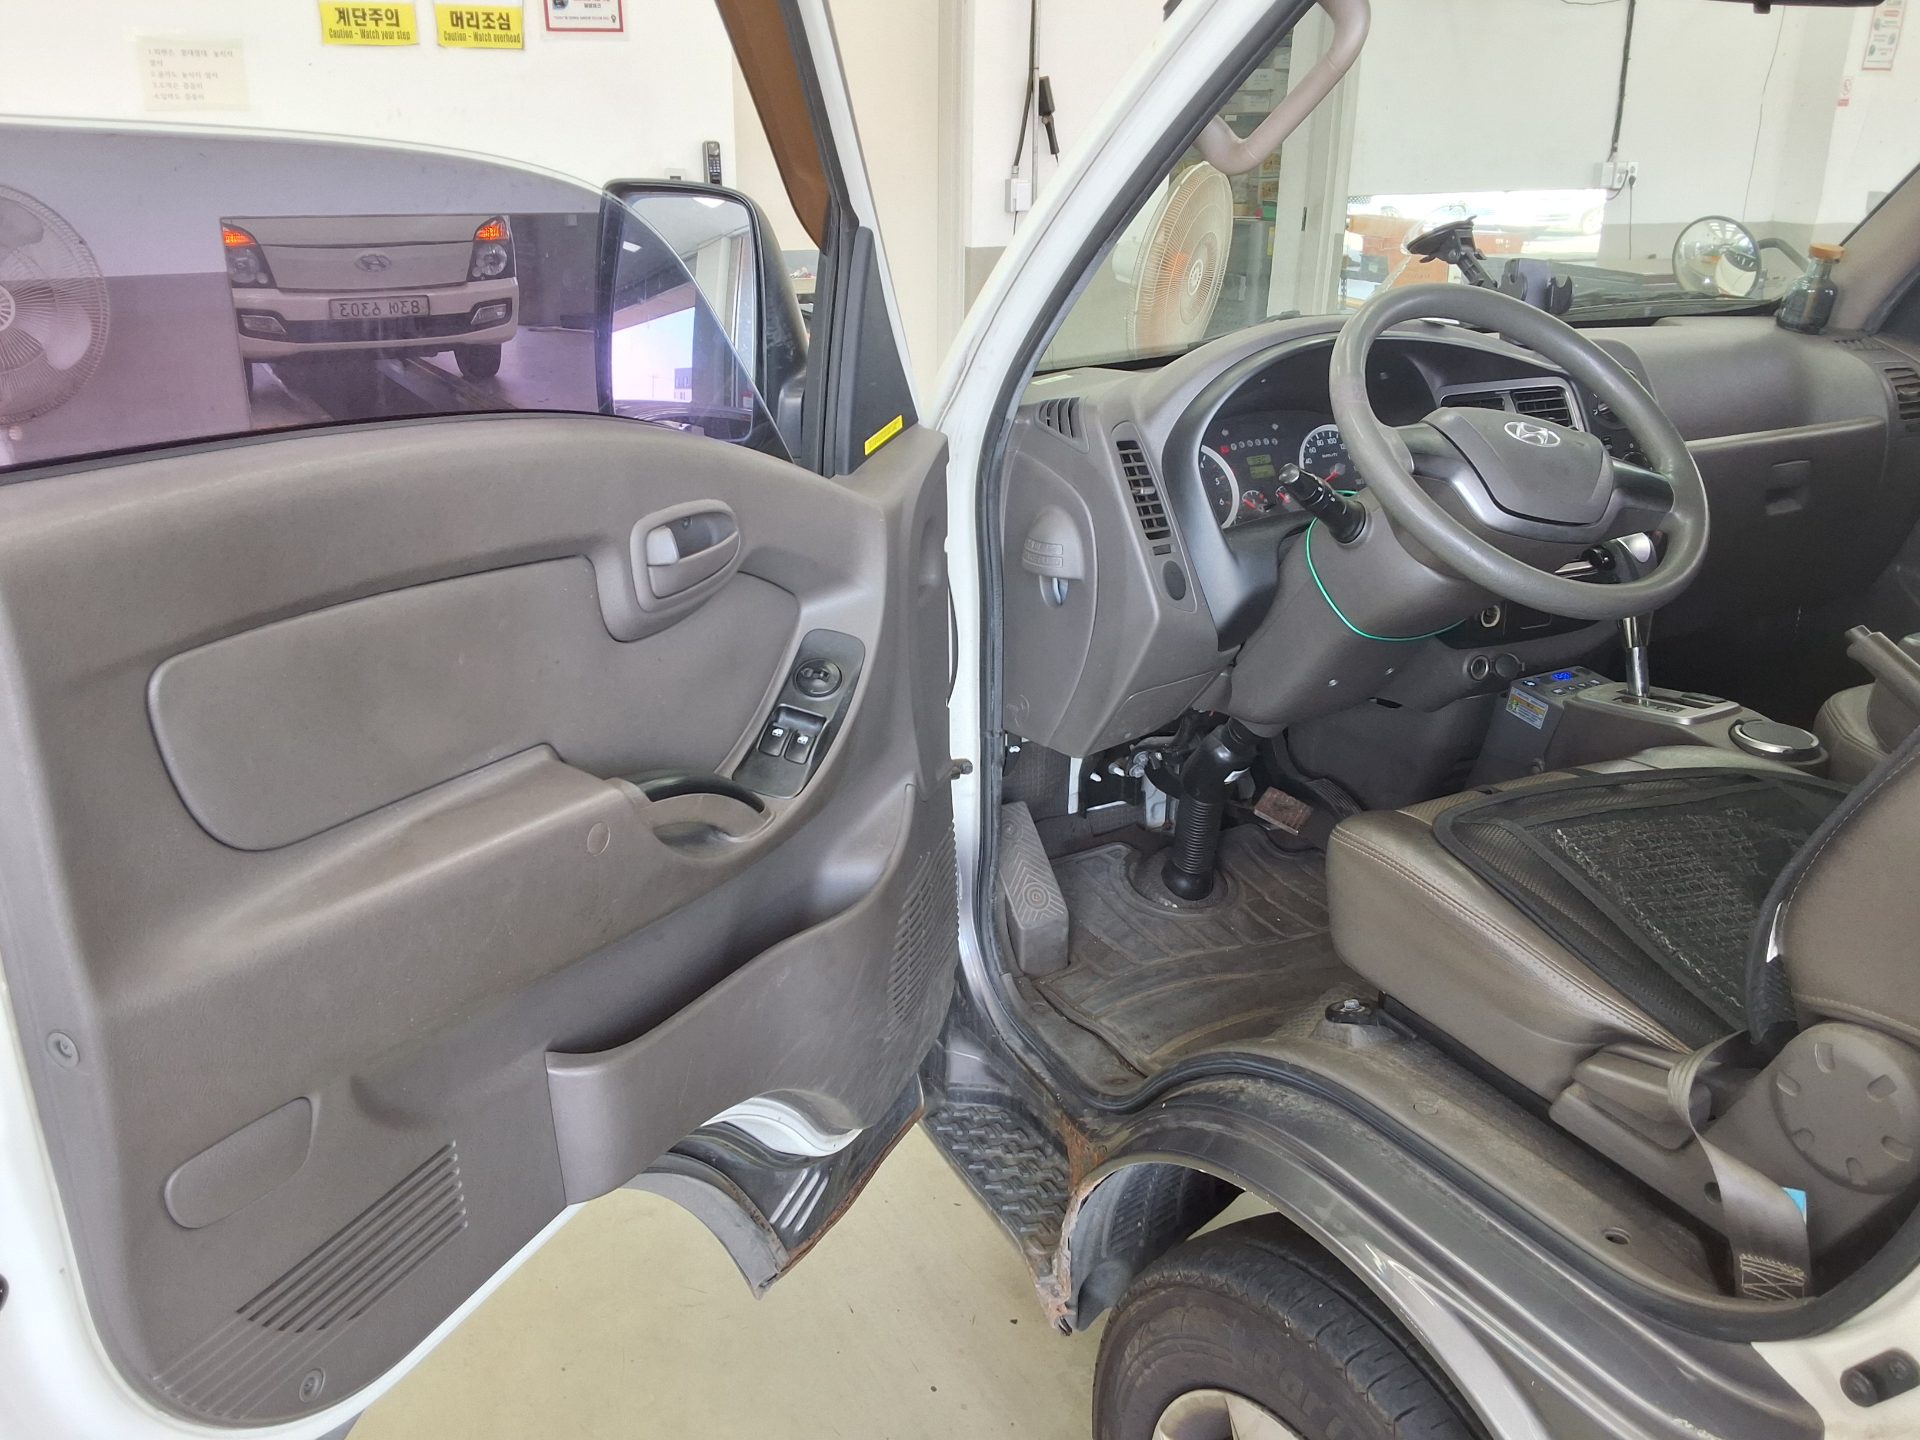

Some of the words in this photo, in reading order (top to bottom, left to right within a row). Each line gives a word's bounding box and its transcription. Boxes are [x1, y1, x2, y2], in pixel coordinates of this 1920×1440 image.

[334, 7, 401, 28] 계단주의
[449, 10, 512, 31] 머리조심
[328, 28, 354, 39] Caution
[360, 28, 380, 40] Watch
[381, 30, 395, 40] your
[397, 30, 411, 40] step
[443, 30, 467, 42] Caution
[473, 31, 492, 43] Watch
[493, 33, 521, 43] overhead
[1215, 477, 1220, 485] 5
